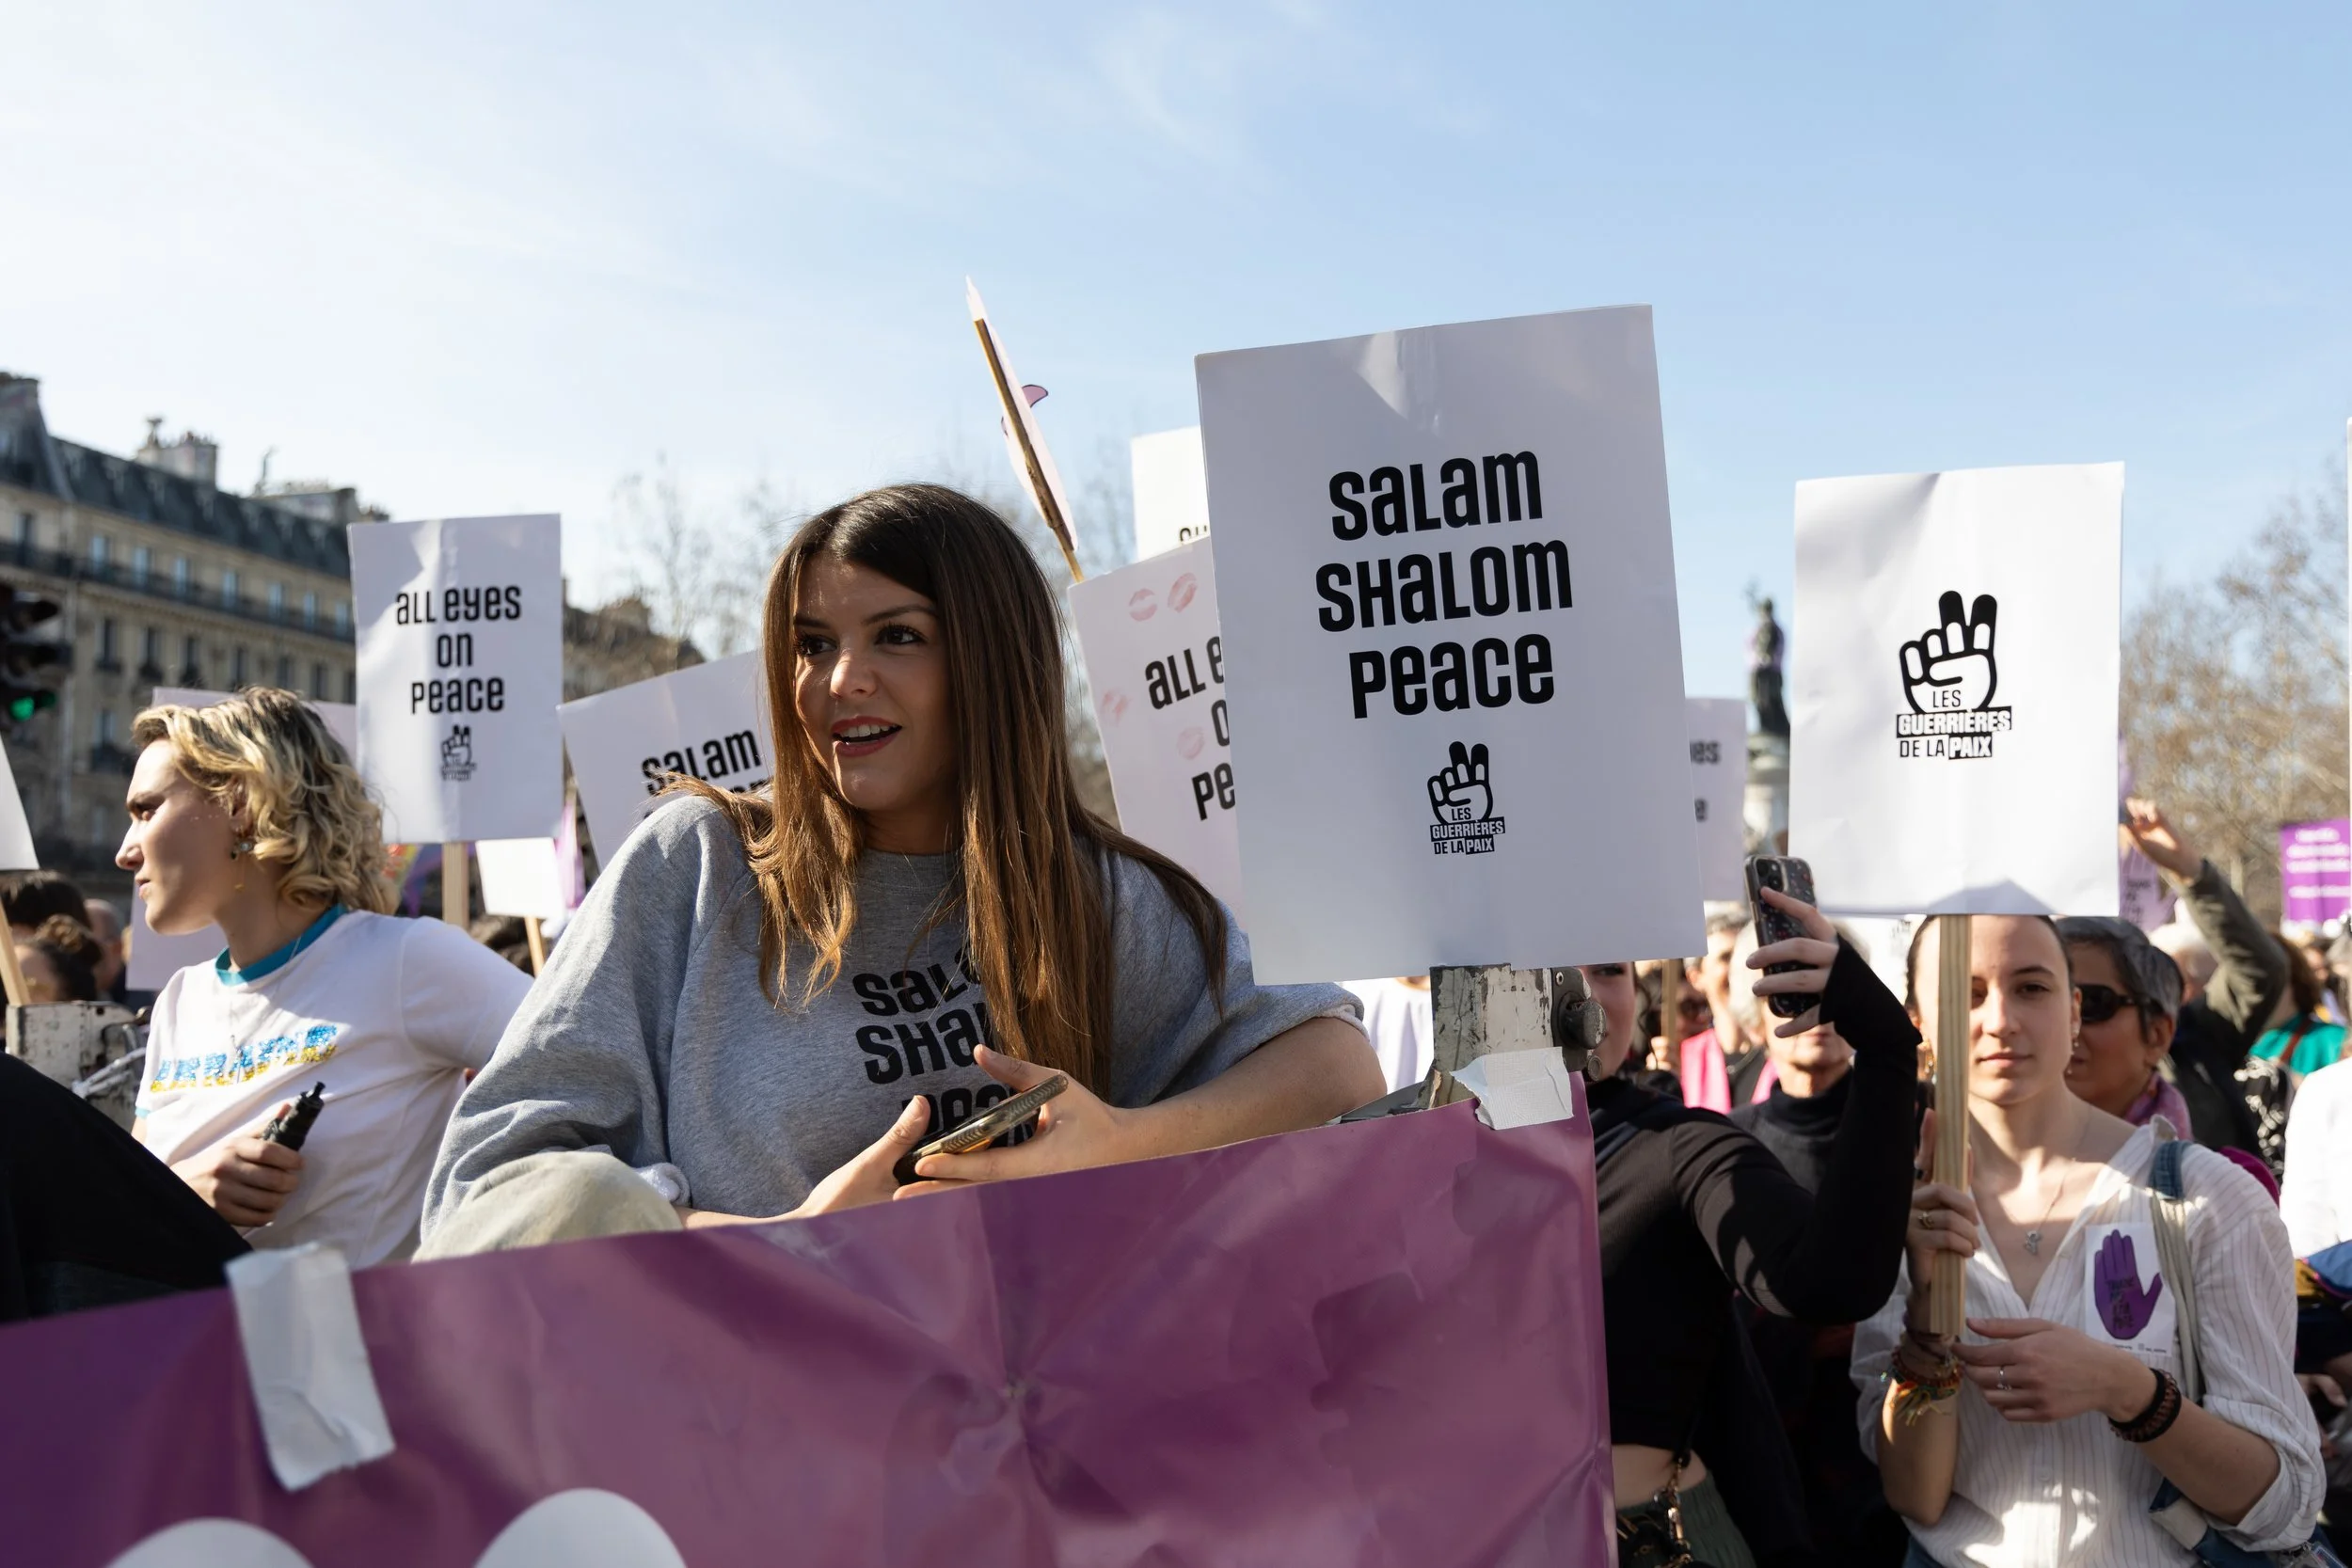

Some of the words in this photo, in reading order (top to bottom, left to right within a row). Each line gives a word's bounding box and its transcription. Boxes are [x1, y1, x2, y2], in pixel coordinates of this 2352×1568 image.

[1932, 689, 1962, 708] LES
[1899, 739, 1920, 758] DE
[1927, 739, 1945, 757] LA
[1948, 736, 1992, 759] PAIX
[1451, 806, 1471, 821] LES
[1434, 841, 1448, 855] DE
[1451, 840, 1464, 854] LA
[1465, 837, 1494, 854] PAIX
